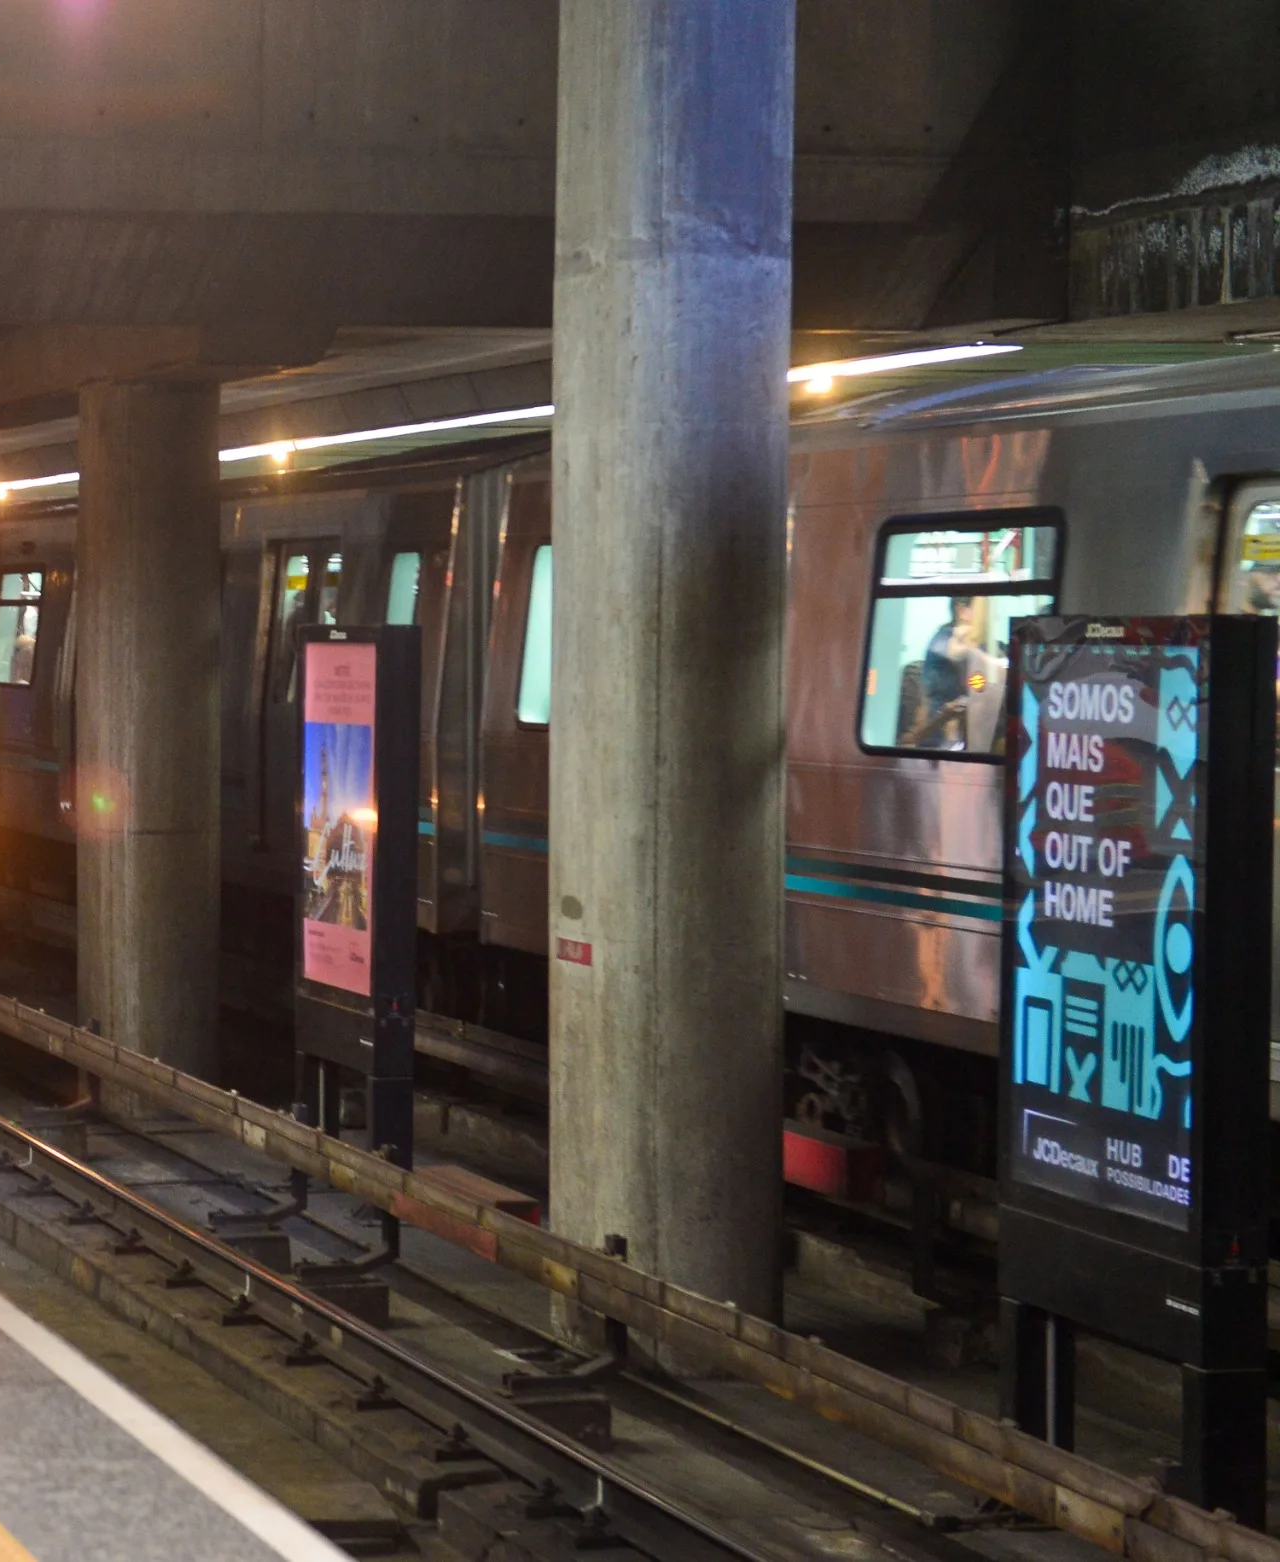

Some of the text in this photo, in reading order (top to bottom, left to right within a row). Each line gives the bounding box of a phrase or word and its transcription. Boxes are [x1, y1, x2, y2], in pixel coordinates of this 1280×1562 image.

[1048, 681, 1135, 724] SOMOS
[1046, 732, 1105, 773] MAIS
[1045, 781, 1095, 823] QUE
[1044, 831, 1132, 878] OUT OF
[1043, 880, 1114, 928] HOME
[1033, 1137, 1099, 1178] JCDecaux
[1106, 1137, 1190, 1183] HUB DE
